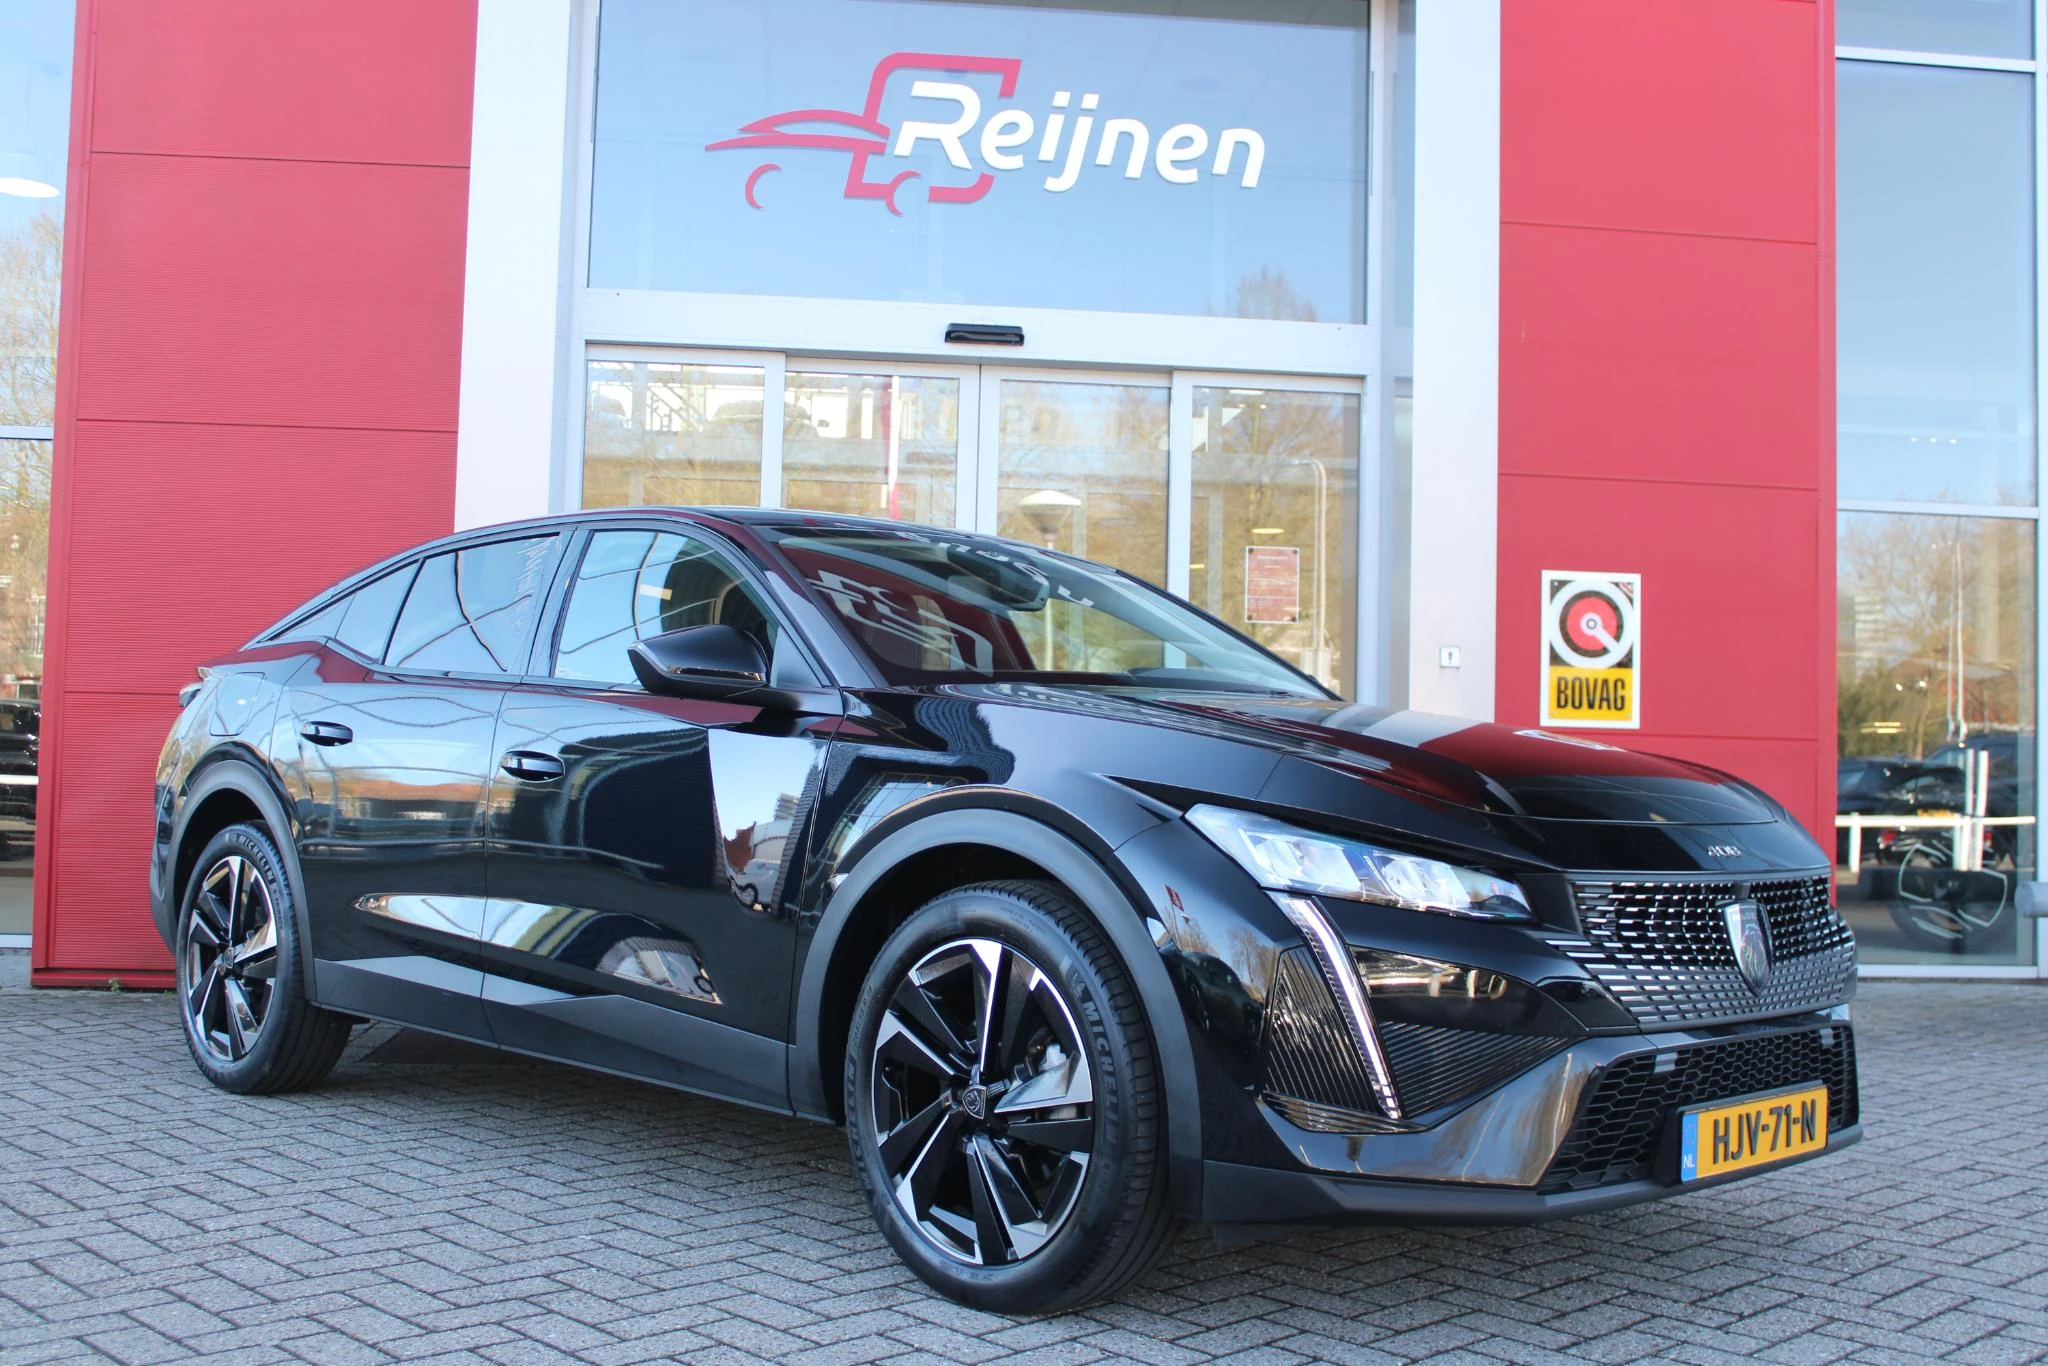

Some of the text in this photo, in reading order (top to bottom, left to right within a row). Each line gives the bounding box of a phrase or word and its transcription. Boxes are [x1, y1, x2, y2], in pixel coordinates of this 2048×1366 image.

[894, 81, 1265, 192] Reijnen
[1556, 676, 1626, 711] BOVAG
[239, 835, 275, 881] MICHELIN
[1082, 1000, 1118, 1145] MICHELIN
[1713, 1099, 1817, 1165] HJV-71-N
[1683, 1153, 1696, 1169] NL
